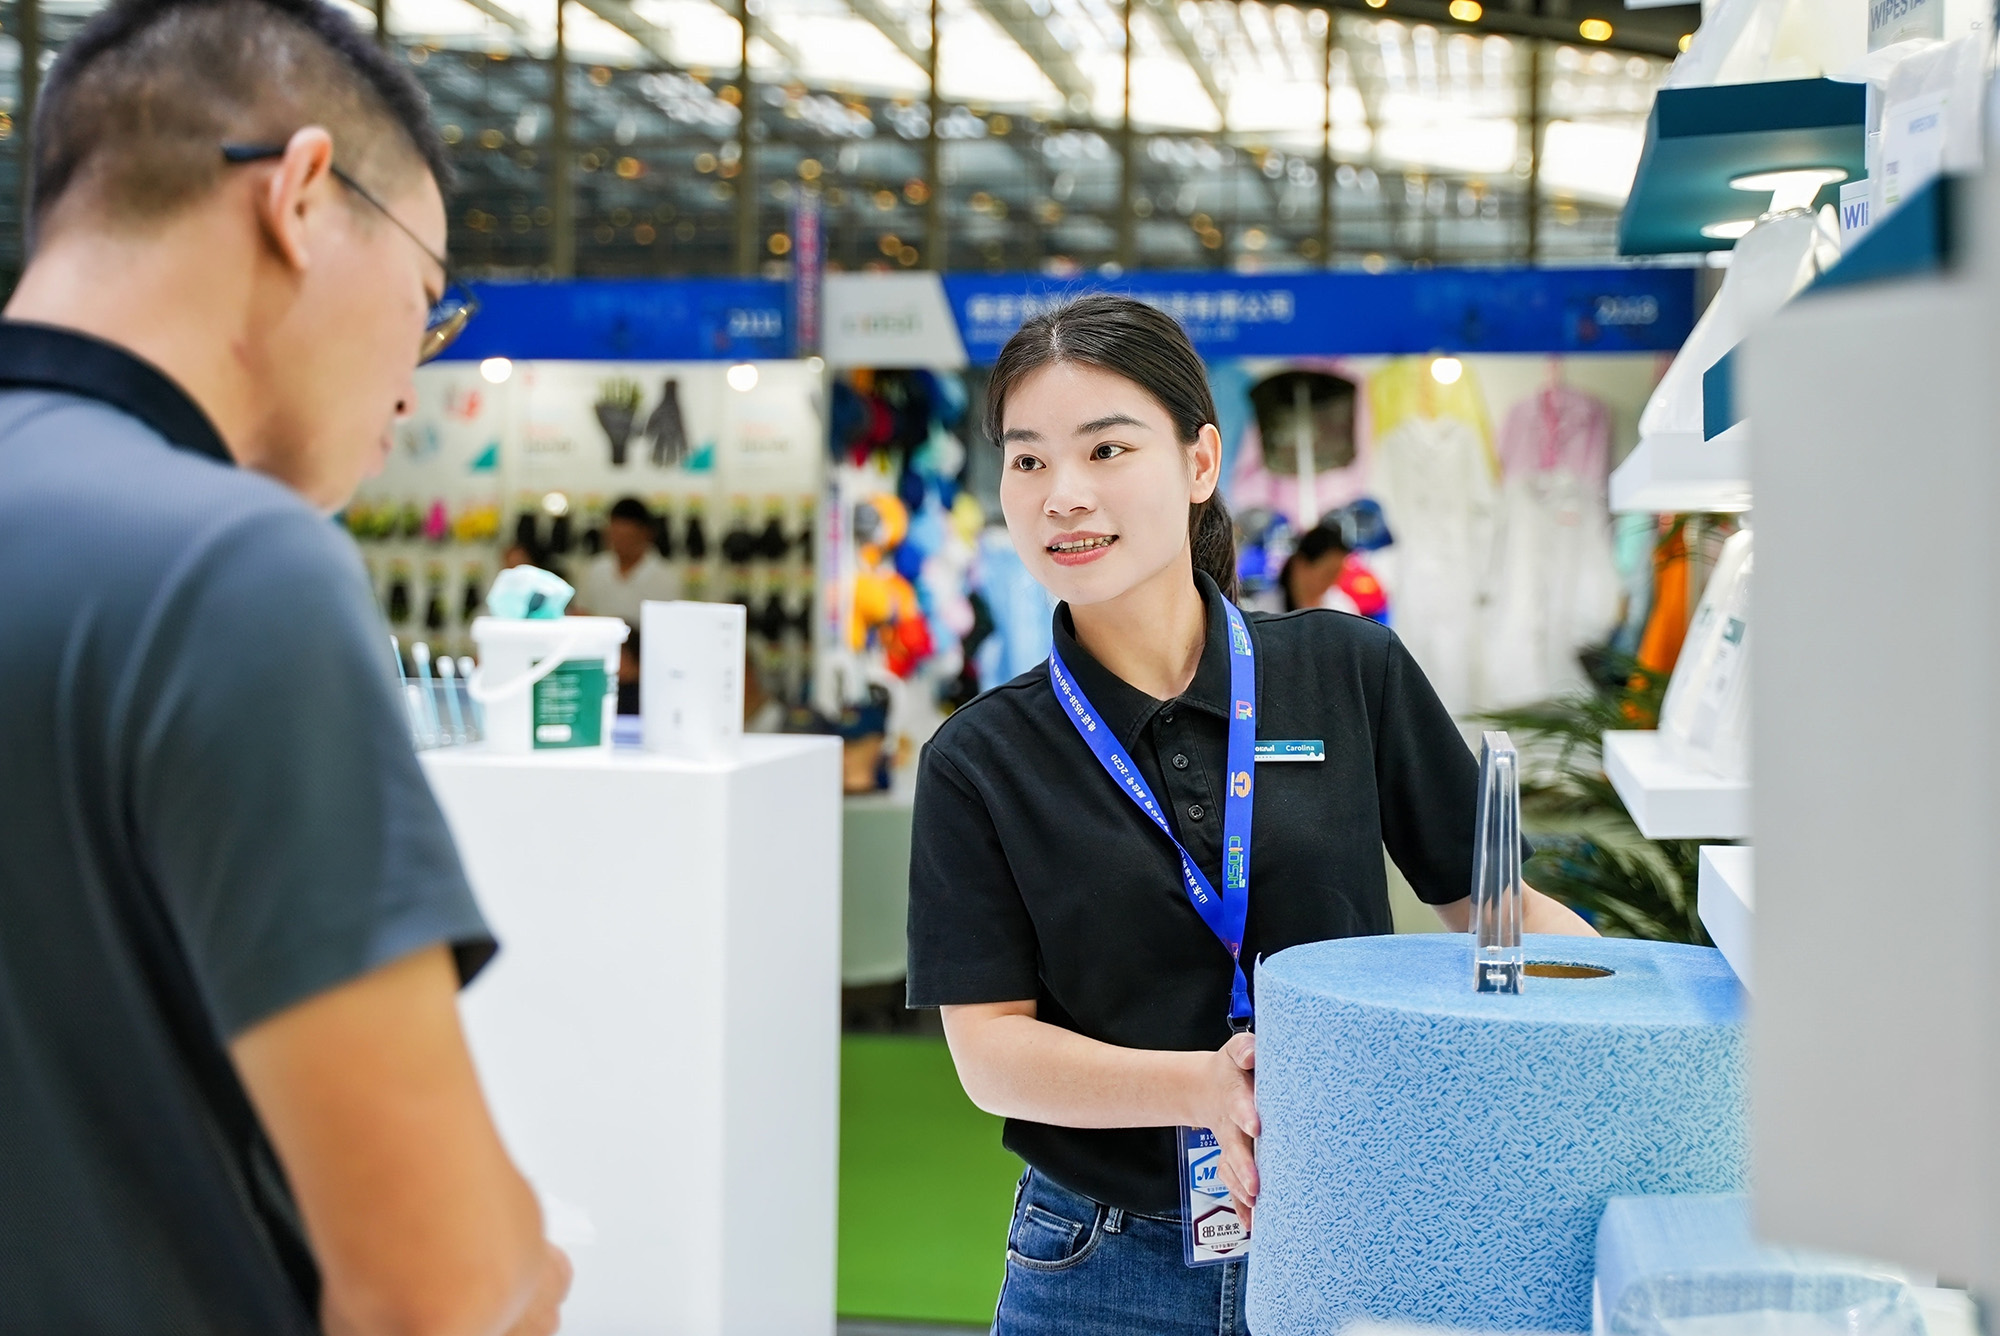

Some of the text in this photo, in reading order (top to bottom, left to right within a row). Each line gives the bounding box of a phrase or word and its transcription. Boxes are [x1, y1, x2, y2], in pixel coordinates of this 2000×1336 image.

[1285, 744, 1315, 752] Carolina
[1217, 1222, 1240, 1232] 百业安
